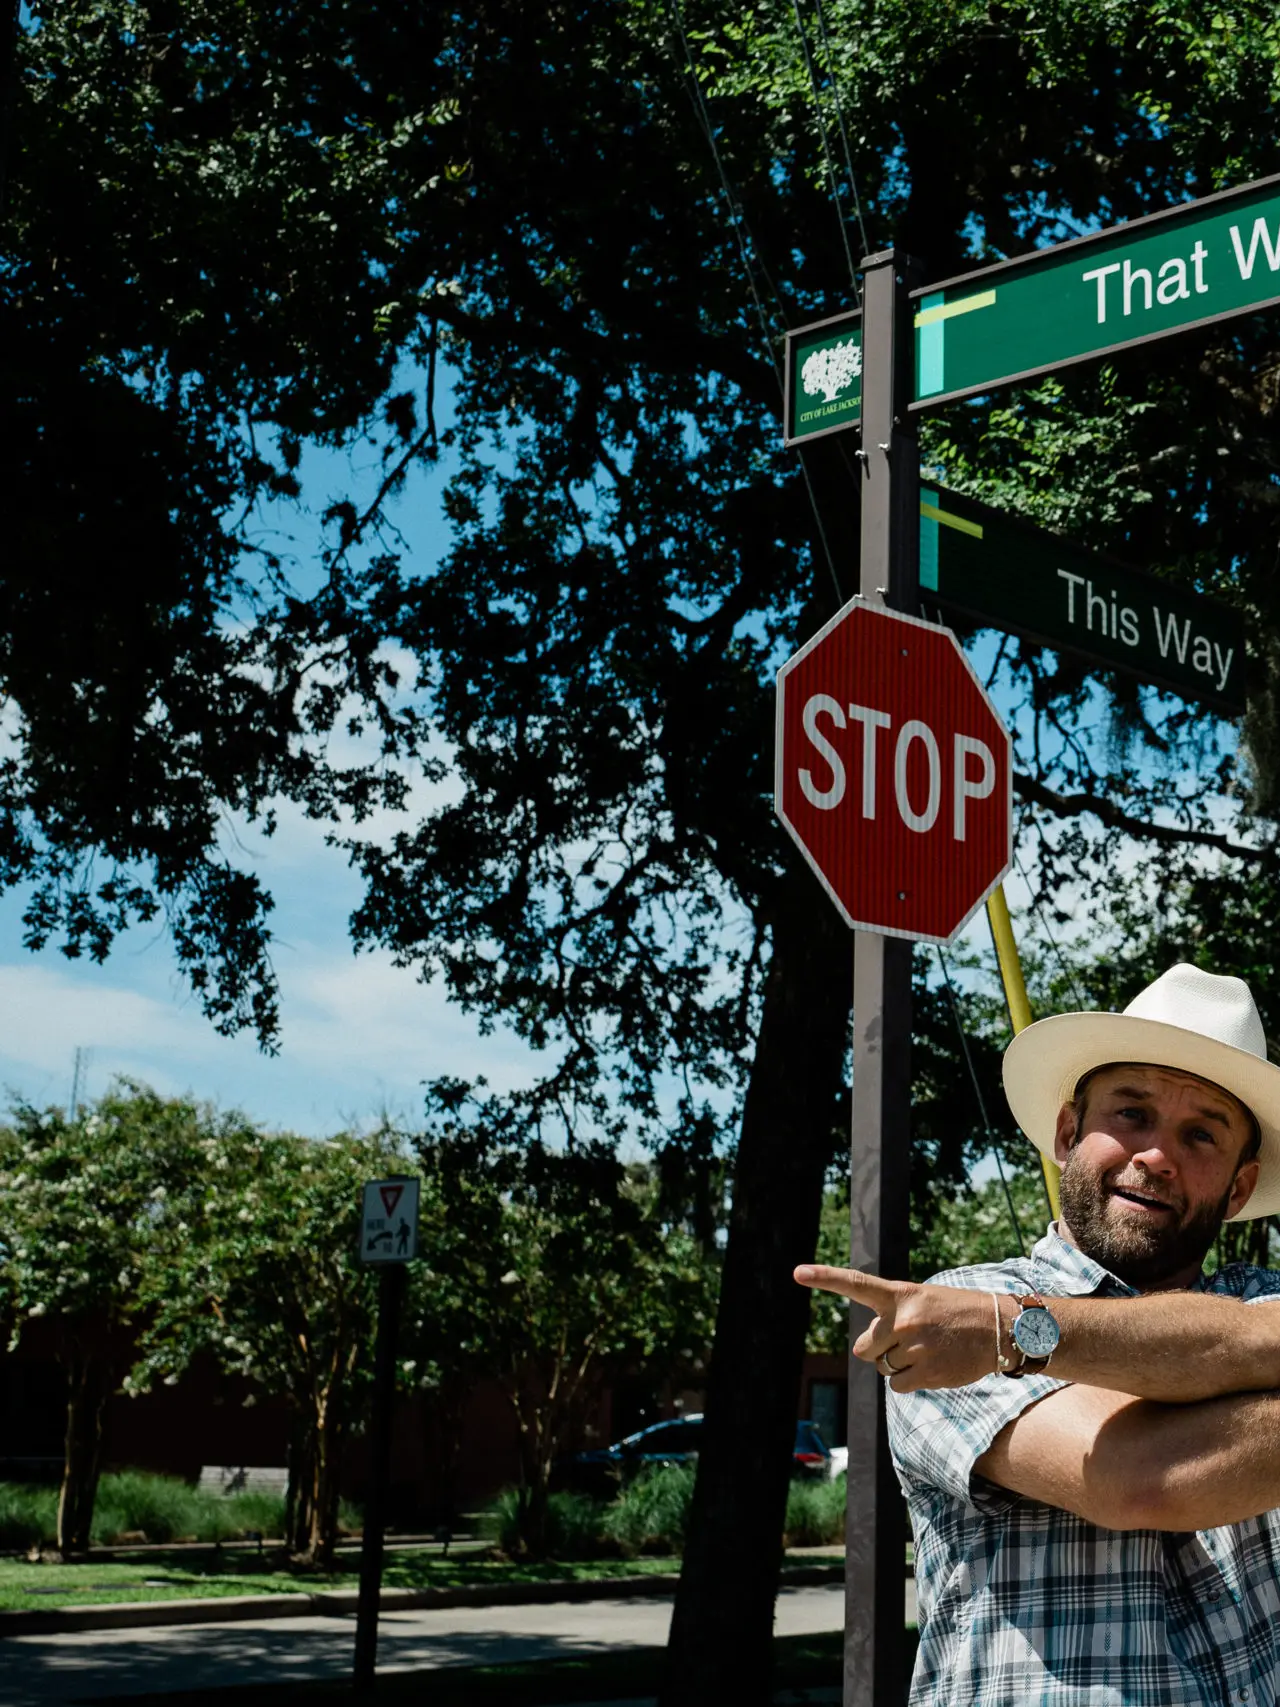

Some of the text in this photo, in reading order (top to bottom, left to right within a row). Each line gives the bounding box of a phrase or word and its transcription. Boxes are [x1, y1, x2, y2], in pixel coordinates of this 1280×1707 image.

[1082, 240, 1209, 324] That
[800, 396, 862, 422] CITY OF LAKE JACKSO
[1057, 568, 1234, 692] This Way
[798, 693, 996, 842] STOP
